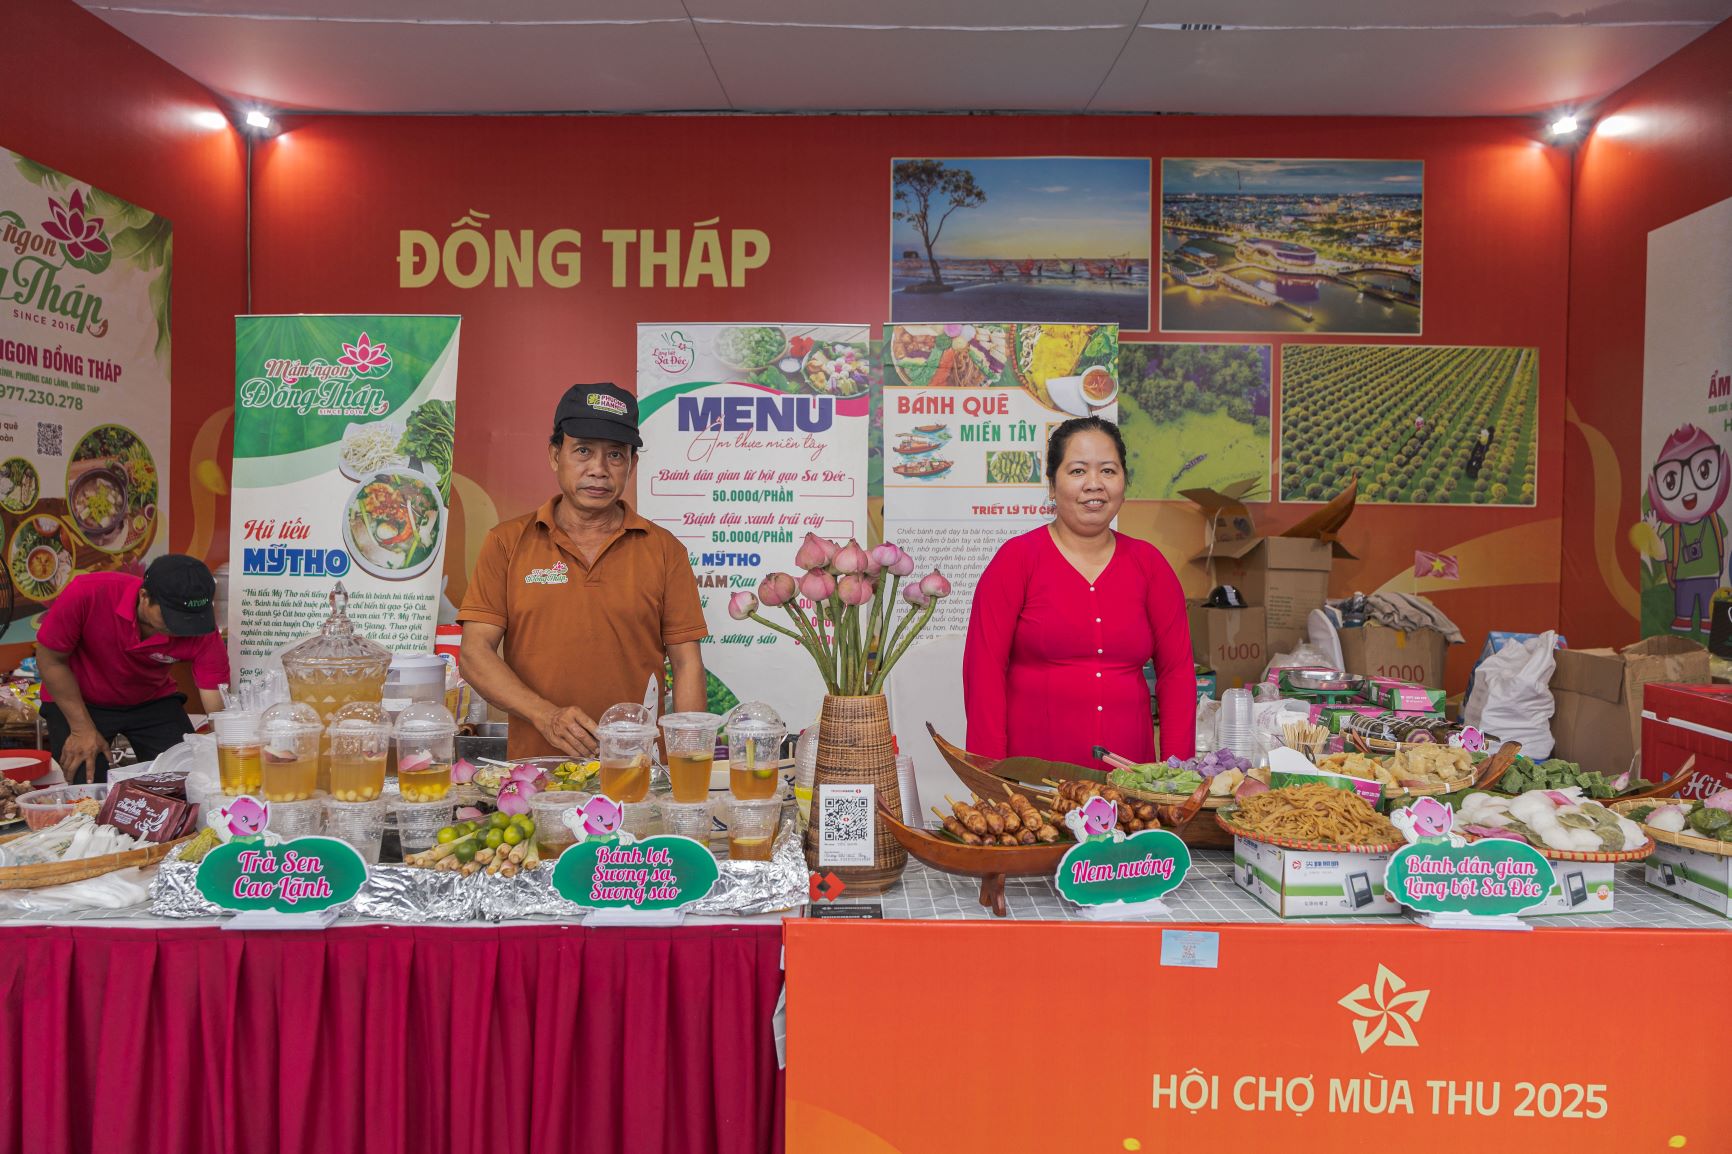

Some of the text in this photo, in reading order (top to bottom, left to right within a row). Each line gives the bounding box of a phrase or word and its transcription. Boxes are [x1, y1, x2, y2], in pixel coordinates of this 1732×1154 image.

[396, 208, 771, 289] ĐỒNG THÁP
[13, 309, 76, 333] SINCE 2016
[42, 344, 84, 377] ĐỒNG
[87, 358, 122, 383] THÁP
[241, 378, 390, 416] Đồng Tháp
[897, 391, 1009, 418] BÁNH QUÊ
[678, 396, 833, 433] MENU
[1008, 419, 1037, 442] TÂY
[802, 432, 828, 461] tây
[658, 467, 846, 484] Bánh dân gian từ bột gạo Sa Đéc
[712, 485, 794, 502] 50.000đ/PHẦN
[719, 512, 742, 528] đậu
[744, 512, 775, 525] xanh
[778, 512, 801, 525] trái
[803, 513, 824, 528] cây
[972, 503, 1005, 515] TRIẾT
[1006, 503, 1020, 515] LÝ
[244, 517, 311, 542] Hủ tiếu
[712, 527, 793, 544] 50.000đ/PHẦN
[243, 543, 351, 578] MỸTHO
[729, 574, 757, 588] Rau
[756, 633, 778, 645] sáo
[237, 850, 323, 874] Trà Sen
[595, 846, 674, 867] Bánh lọt,
[1070, 852, 1176, 885] Nem nướng
[1406, 853, 1538, 883] Bánh dân gian
[592, 865, 678, 886] Sương sa,
[1403, 875, 1543, 900] Làng bột Sa Đéc
[233, 874, 333, 905] Cao Lãnh
[589, 882, 681, 906] Sương sáo
[1152, 1067, 1609, 1119] HỘI CHỢ MÙA THU 2025
